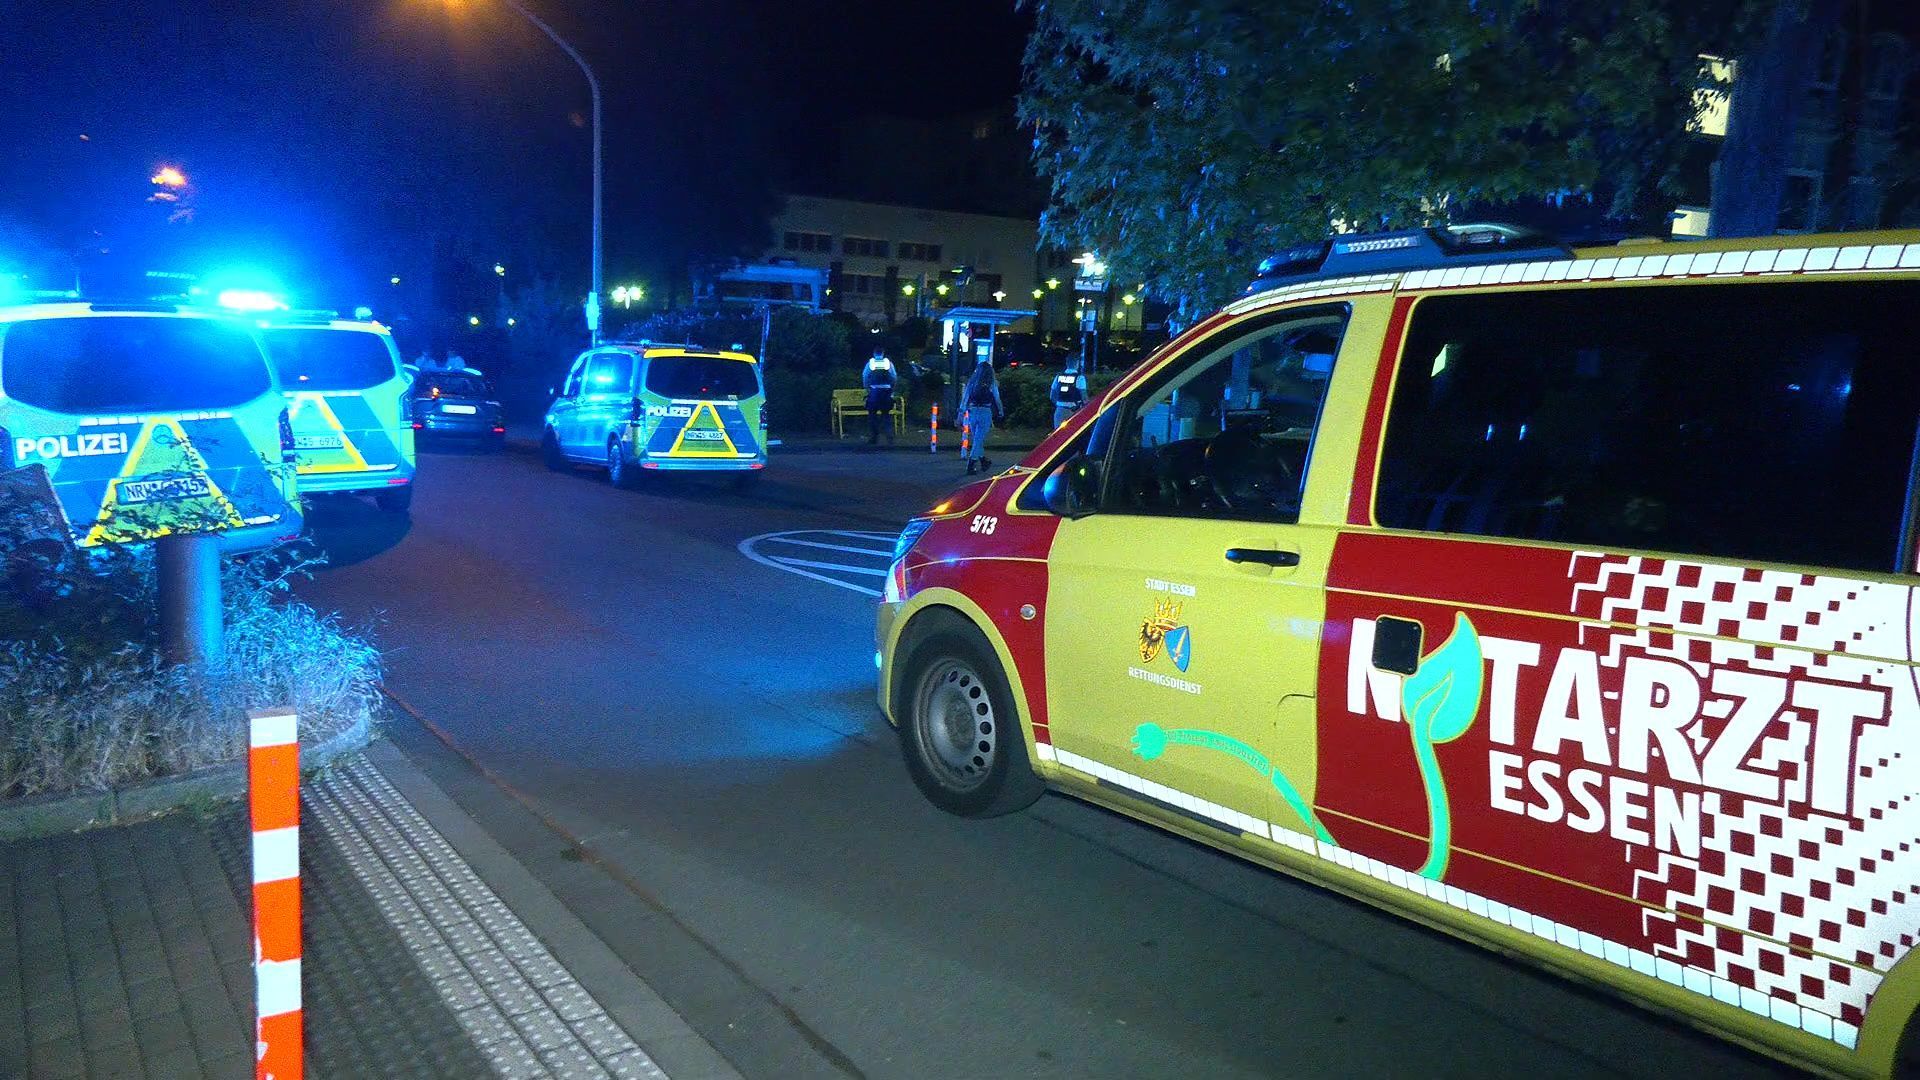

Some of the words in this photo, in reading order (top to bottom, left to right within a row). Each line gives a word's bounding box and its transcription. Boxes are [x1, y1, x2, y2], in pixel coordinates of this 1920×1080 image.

[648, 405, 692, 418] POLIZEI
[15, 432, 128, 461] POLIZEI
[969, 514, 998, 535] 5/13
[1144, 578, 1169, 592] STADT
[1170, 582, 1197, 598] ESSEN
[1128, 666, 1202, 695] RETTUNGSDIENST
[1347, 616, 1888, 816] NTARZT
[1488, 749, 1700, 859] ESSEN
